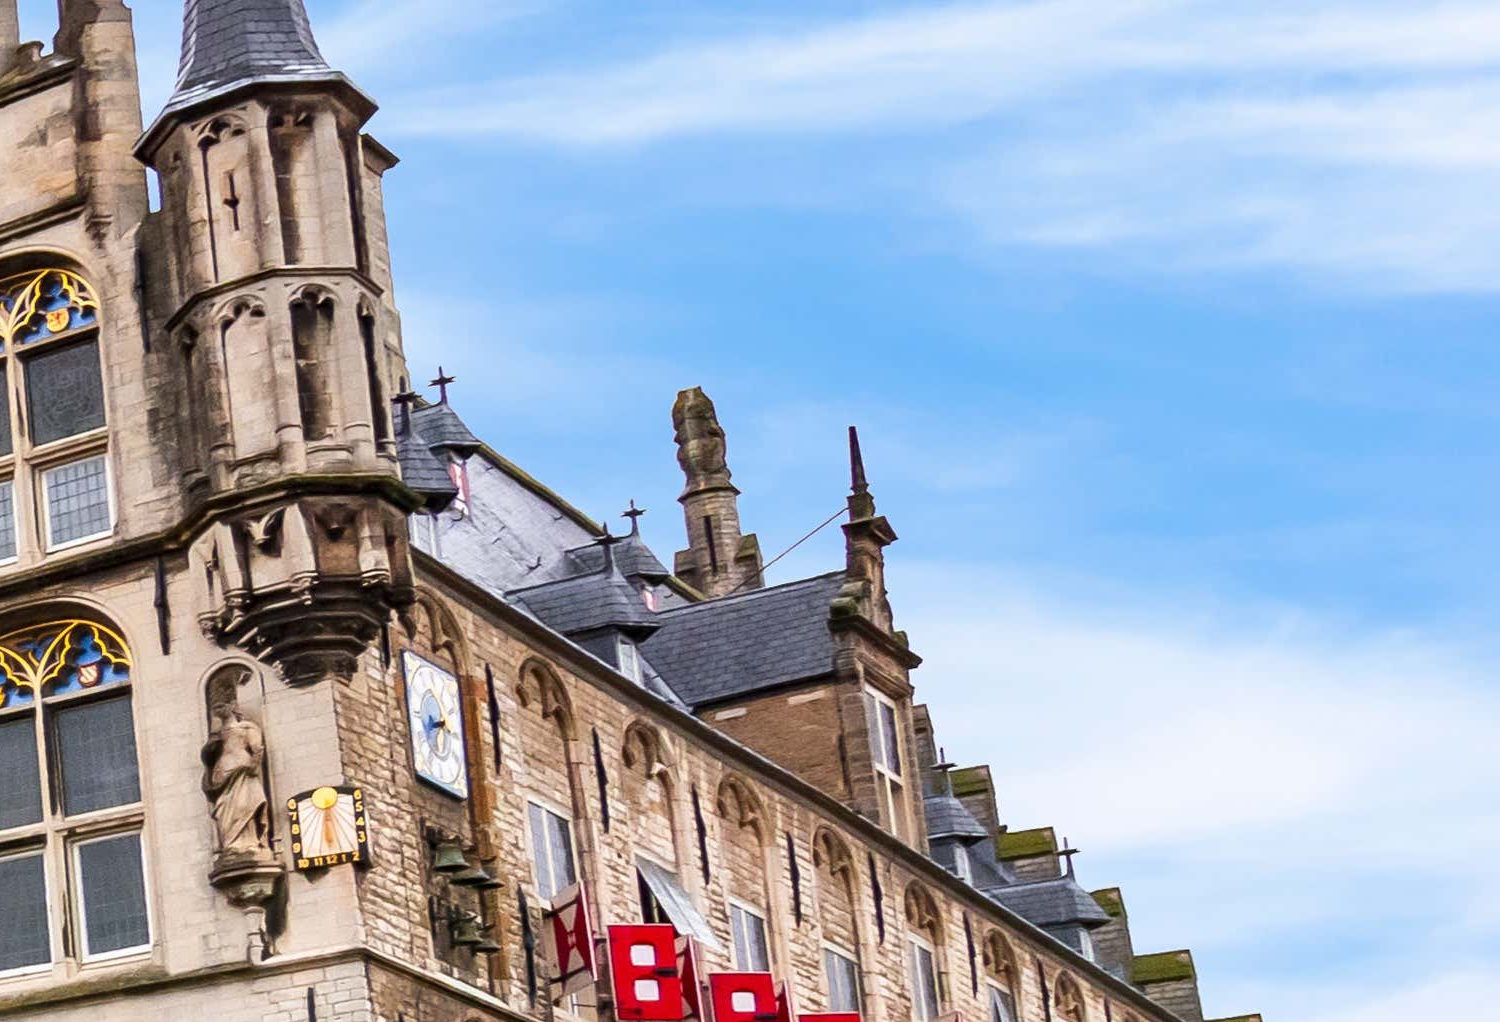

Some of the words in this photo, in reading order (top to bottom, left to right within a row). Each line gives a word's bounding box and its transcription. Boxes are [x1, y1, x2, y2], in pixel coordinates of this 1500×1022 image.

[354, 789, 362, 800] 6
[355, 801, 363, 812] 5
[288, 811, 297, 820] 7
[356, 816, 365, 826] 4
[291, 823, 300, 834] 8
[357, 831, 366, 842] 3
[298, 859, 309, 868] 10
[314, 857, 324, 866] 11
[326, 855, 338, 864] 12
[341, 854, 347, 862] 1
[352, 850, 359, 861] 2
